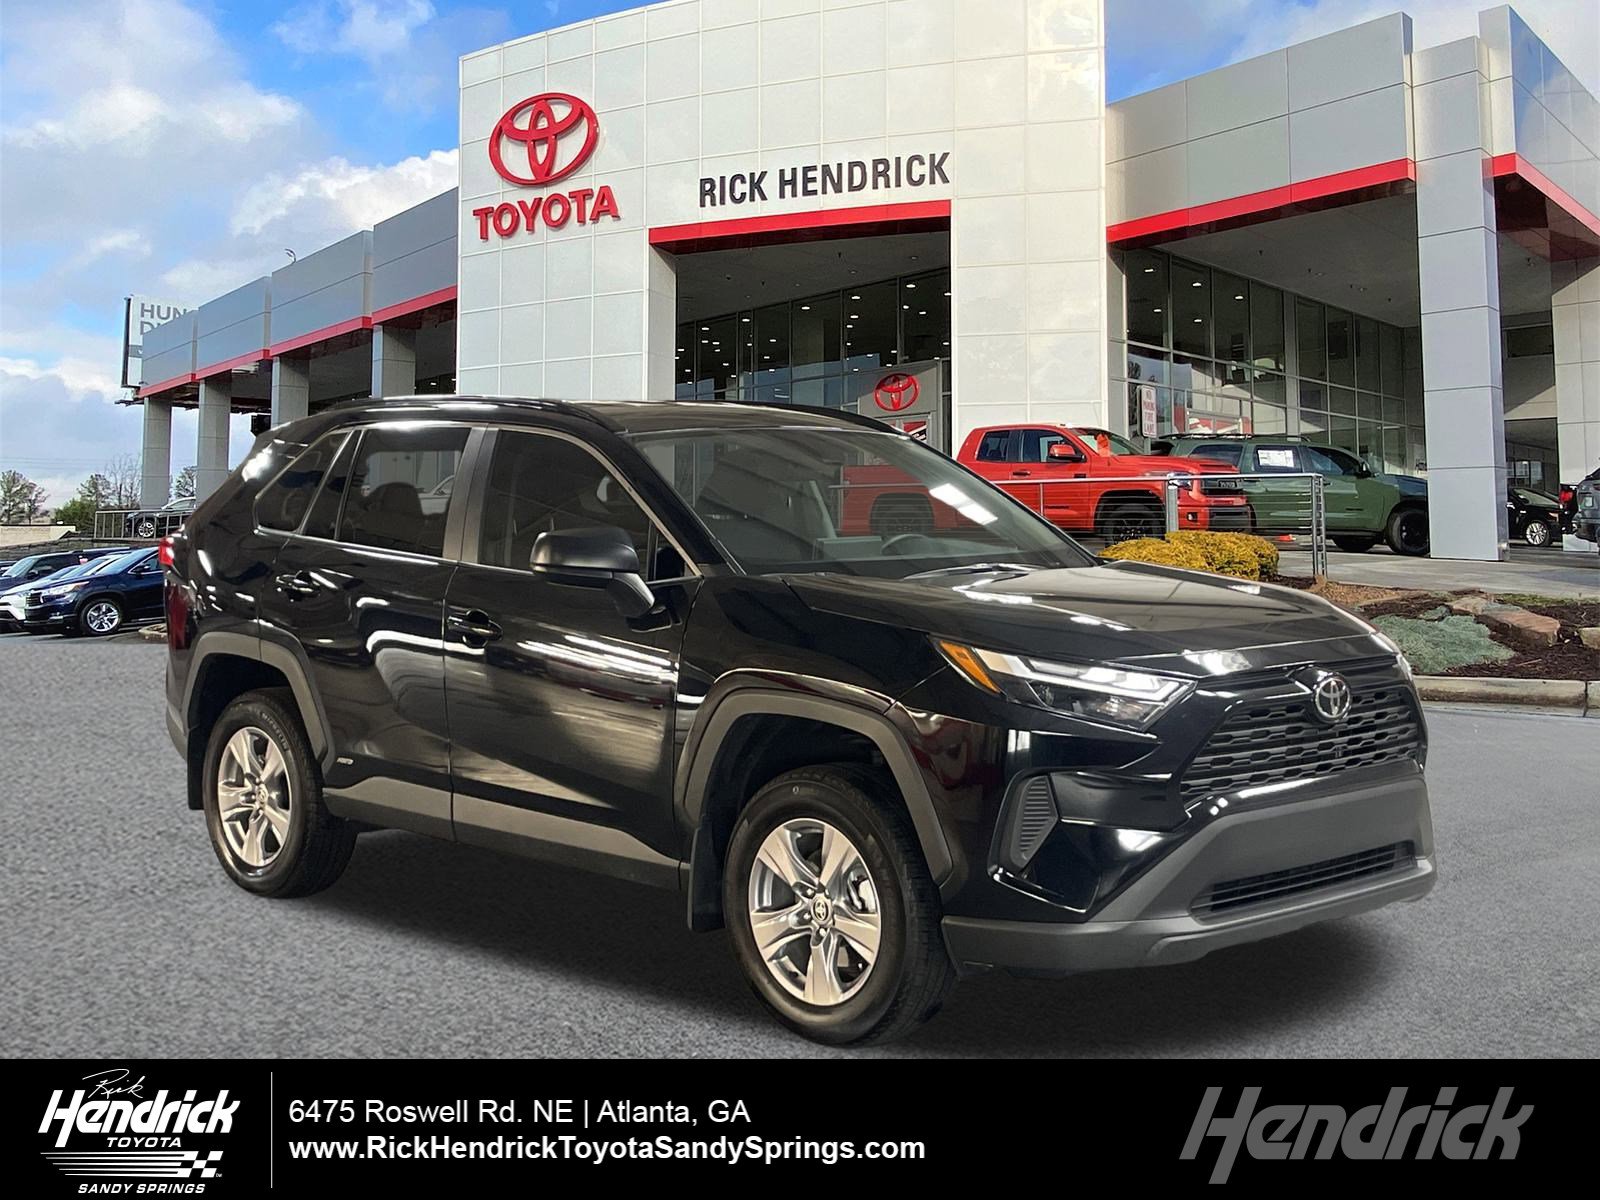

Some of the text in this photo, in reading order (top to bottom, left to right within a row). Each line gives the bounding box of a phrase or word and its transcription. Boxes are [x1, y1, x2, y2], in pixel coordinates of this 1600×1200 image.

[699, 152, 950, 208] RICK HENDRICK
[472, 184, 620, 241] TOYOTA
